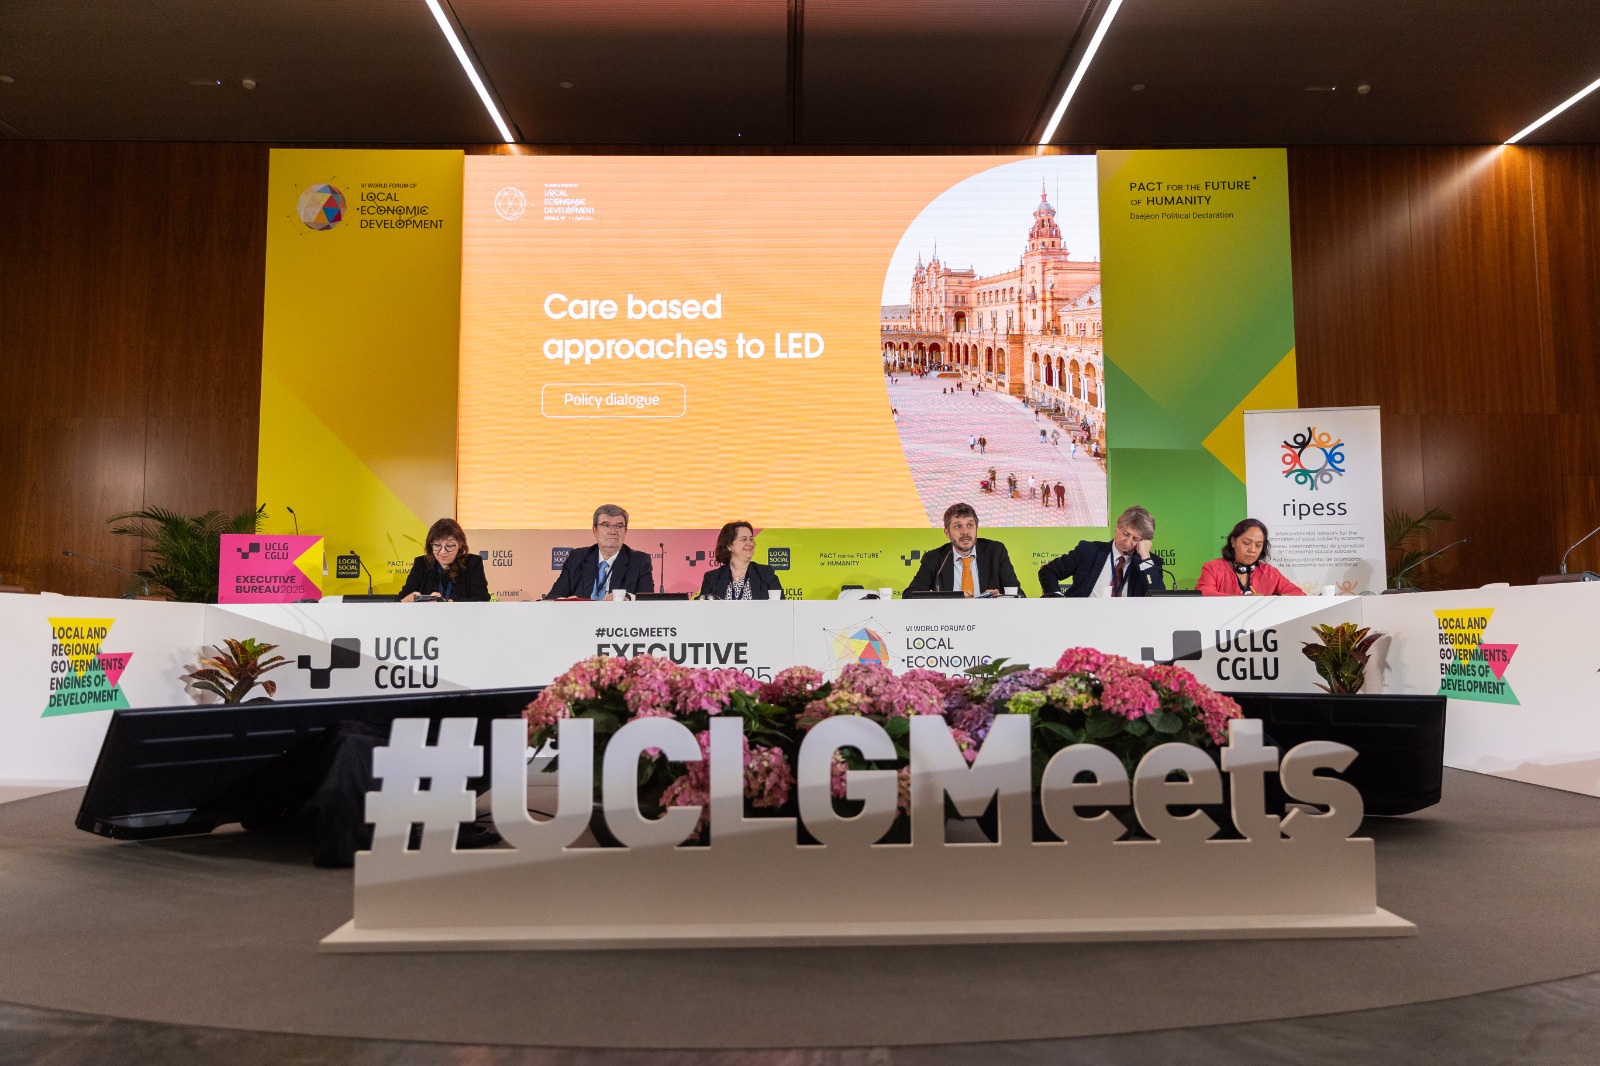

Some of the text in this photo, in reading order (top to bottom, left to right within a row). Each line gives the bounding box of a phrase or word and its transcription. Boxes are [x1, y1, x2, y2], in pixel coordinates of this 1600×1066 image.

[1130, 182, 1163, 191] PACT
[1205, 181, 1250, 190] FUTURE
[361, 192, 399, 202] LOCAL
[1146, 196, 1212, 206] HUMANITY
[360, 206, 429, 215] ECONOMIC
[1130, 212, 1159, 221] Daejeon
[360, 219, 443, 229] DEVELOPMENT
[544, 293, 722, 320] Care based
[543, 332, 824, 364] approaches to LED
[564, 393, 660, 408] Policy dialogue
[1283, 499, 1347, 520] ripess
[265, 543, 288, 551] UCLG
[1438, 617, 1487, 629] LOCAL AND
[53, 626, 107, 640] LOCAL AND
[595, 627, 677, 637] #UCLGMEETS
[1439, 633, 1483, 645] REGIONAL
[375, 636, 439, 660] UCLG
[906, 637, 954, 650] LOCAL
[1215, 629, 1278, 652] UCLG
[52, 643, 101, 656] REGIONAL
[597, 642, 748, 665] EXECUTIVE
[1439, 648, 1510, 663] GOVERNMENTS,
[51, 658, 125, 673] GOVERNMENTS,
[1217, 657, 1278, 680] CGLU
[1440, 663, 1490, 677] ENGINES OF
[50, 674, 106, 690] ENGINES OF
[375, 665, 438, 689] CGLU
[1441, 678, 1505, 695] DEVELOPMENT
[49, 689, 119, 707] DEVELOPMENT
[364, 713, 1366, 848] #UCLGMeets
